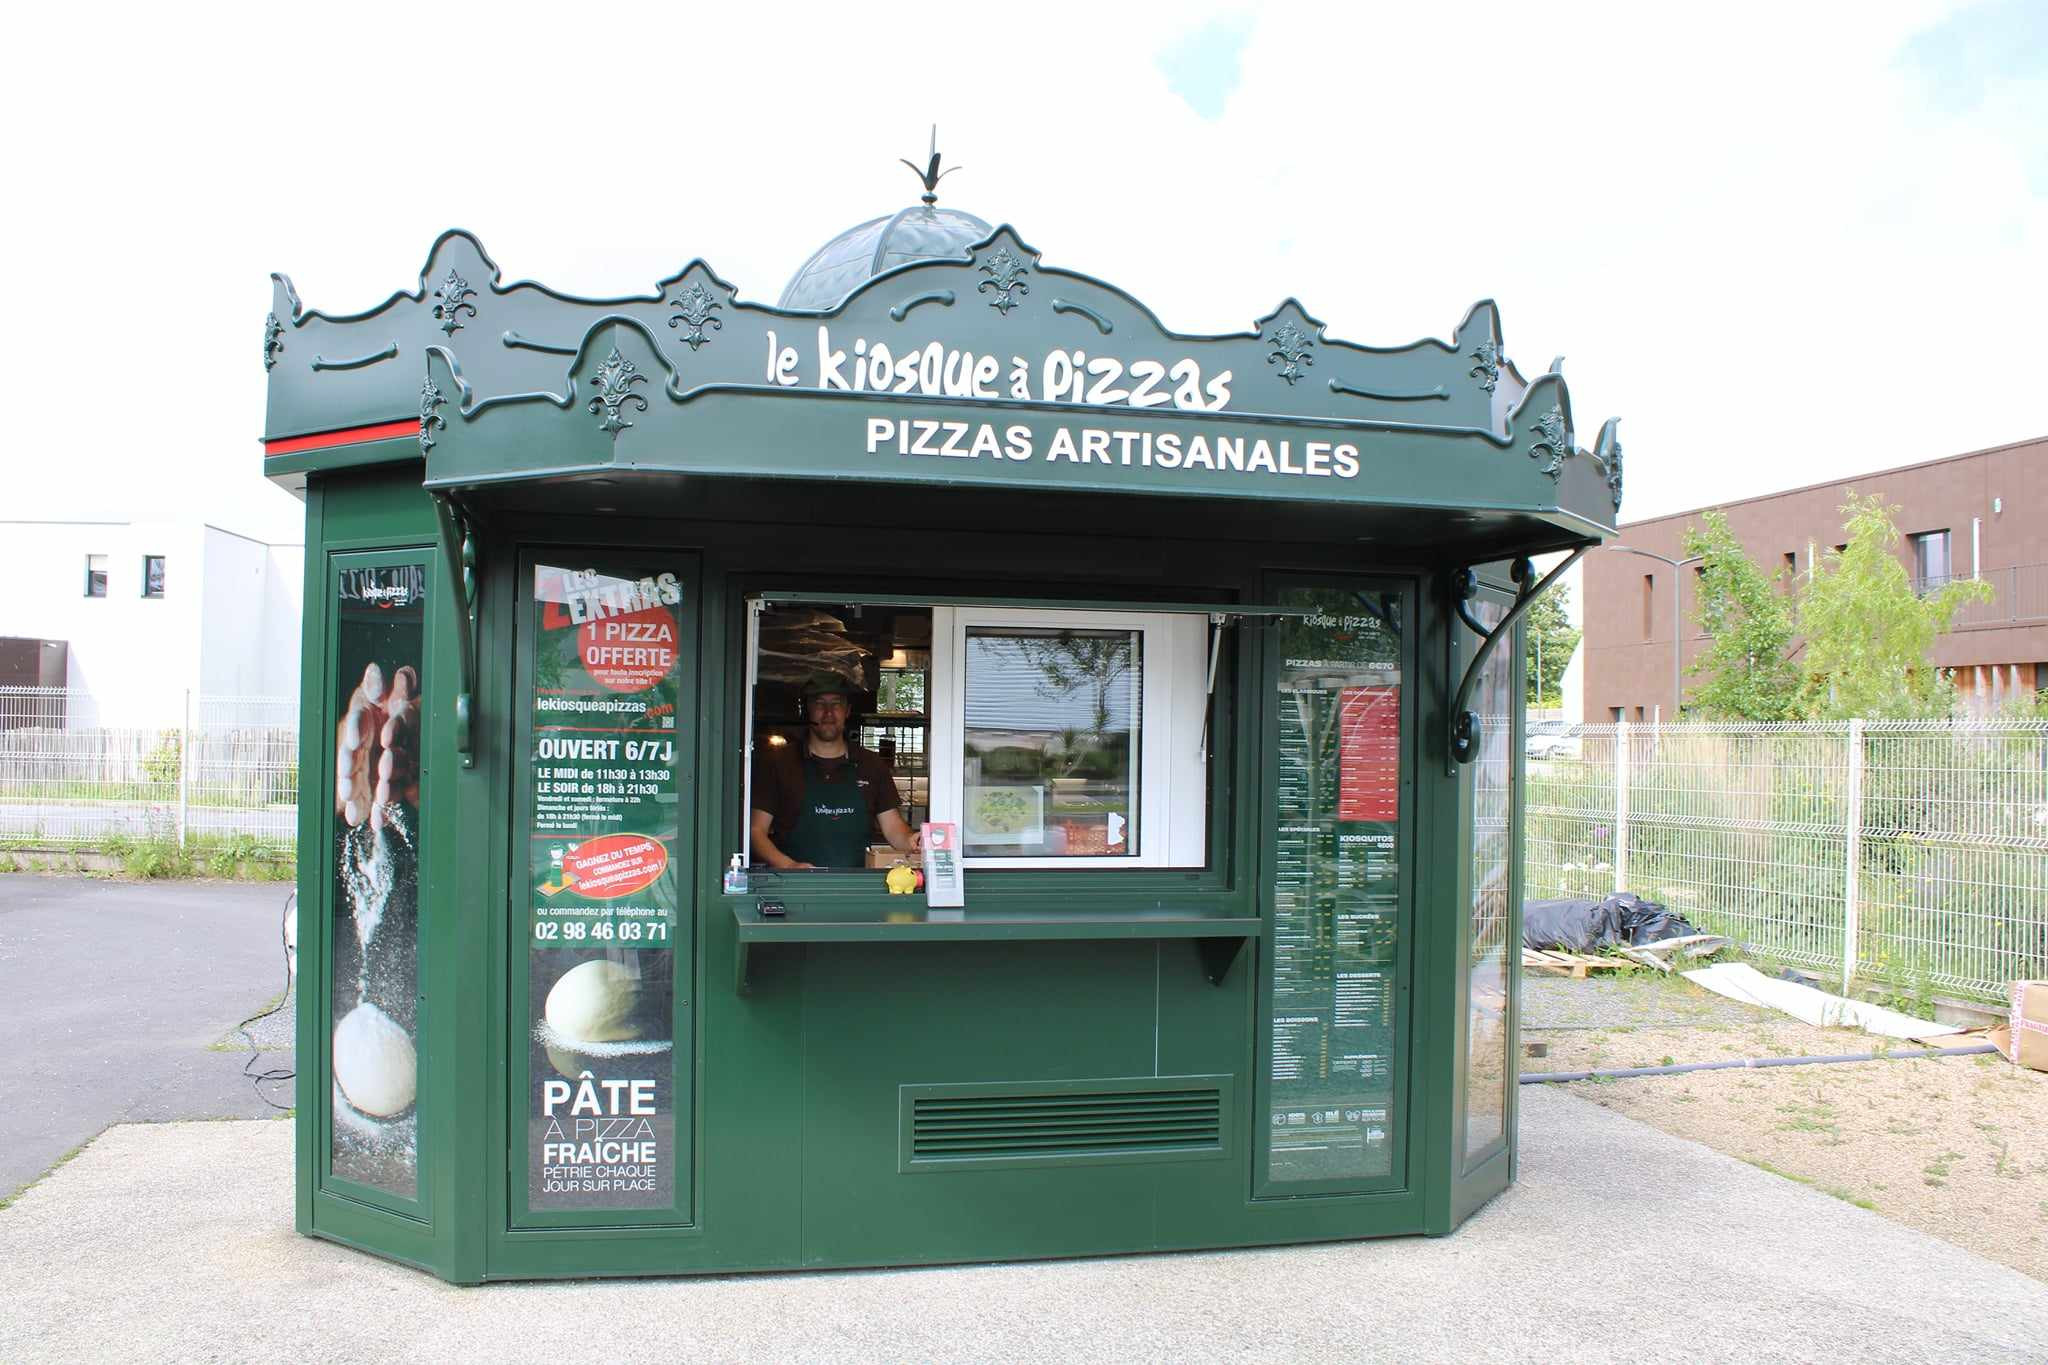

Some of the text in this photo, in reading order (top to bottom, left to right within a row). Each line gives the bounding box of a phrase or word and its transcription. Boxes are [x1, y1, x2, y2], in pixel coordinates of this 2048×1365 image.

[767, 330, 799, 387] le
[818, 326, 999, 400] kiosque
[1010, 356, 1031, 402] à
[866, 417, 1361, 479] PIZZAS ARTISANALES
[587, 623, 672, 643] 1 PIZZA
[586, 647, 672, 667] OFFERTE
[1286, 659, 1322, 668] PIZZAS
[538, 738, 673, 762] OUVERT 6/7J
[537, 768, 670, 781] LE MIDI de 11h30 à 13h30
[537, 782, 659, 795] LE SOIR de 18h à 21h30
[575, 853, 610, 869] GAGNEZ
[610, 850, 624, 860] DU
[537, 907, 668, 918] ou commandez par téléphone au
[535, 921, 667, 940] 02 98 46 03 71
[544, 1070, 656, 1116] PÂTE
[544, 1114, 656, 1140] À PIZZA
[543, 1137, 657, 1165] FRAÎCHE
[543, 1164, 657, 1179] PÉTRIE CHAQUE
[543, 1178, 656, 1192] JOUR SUR PLACE
